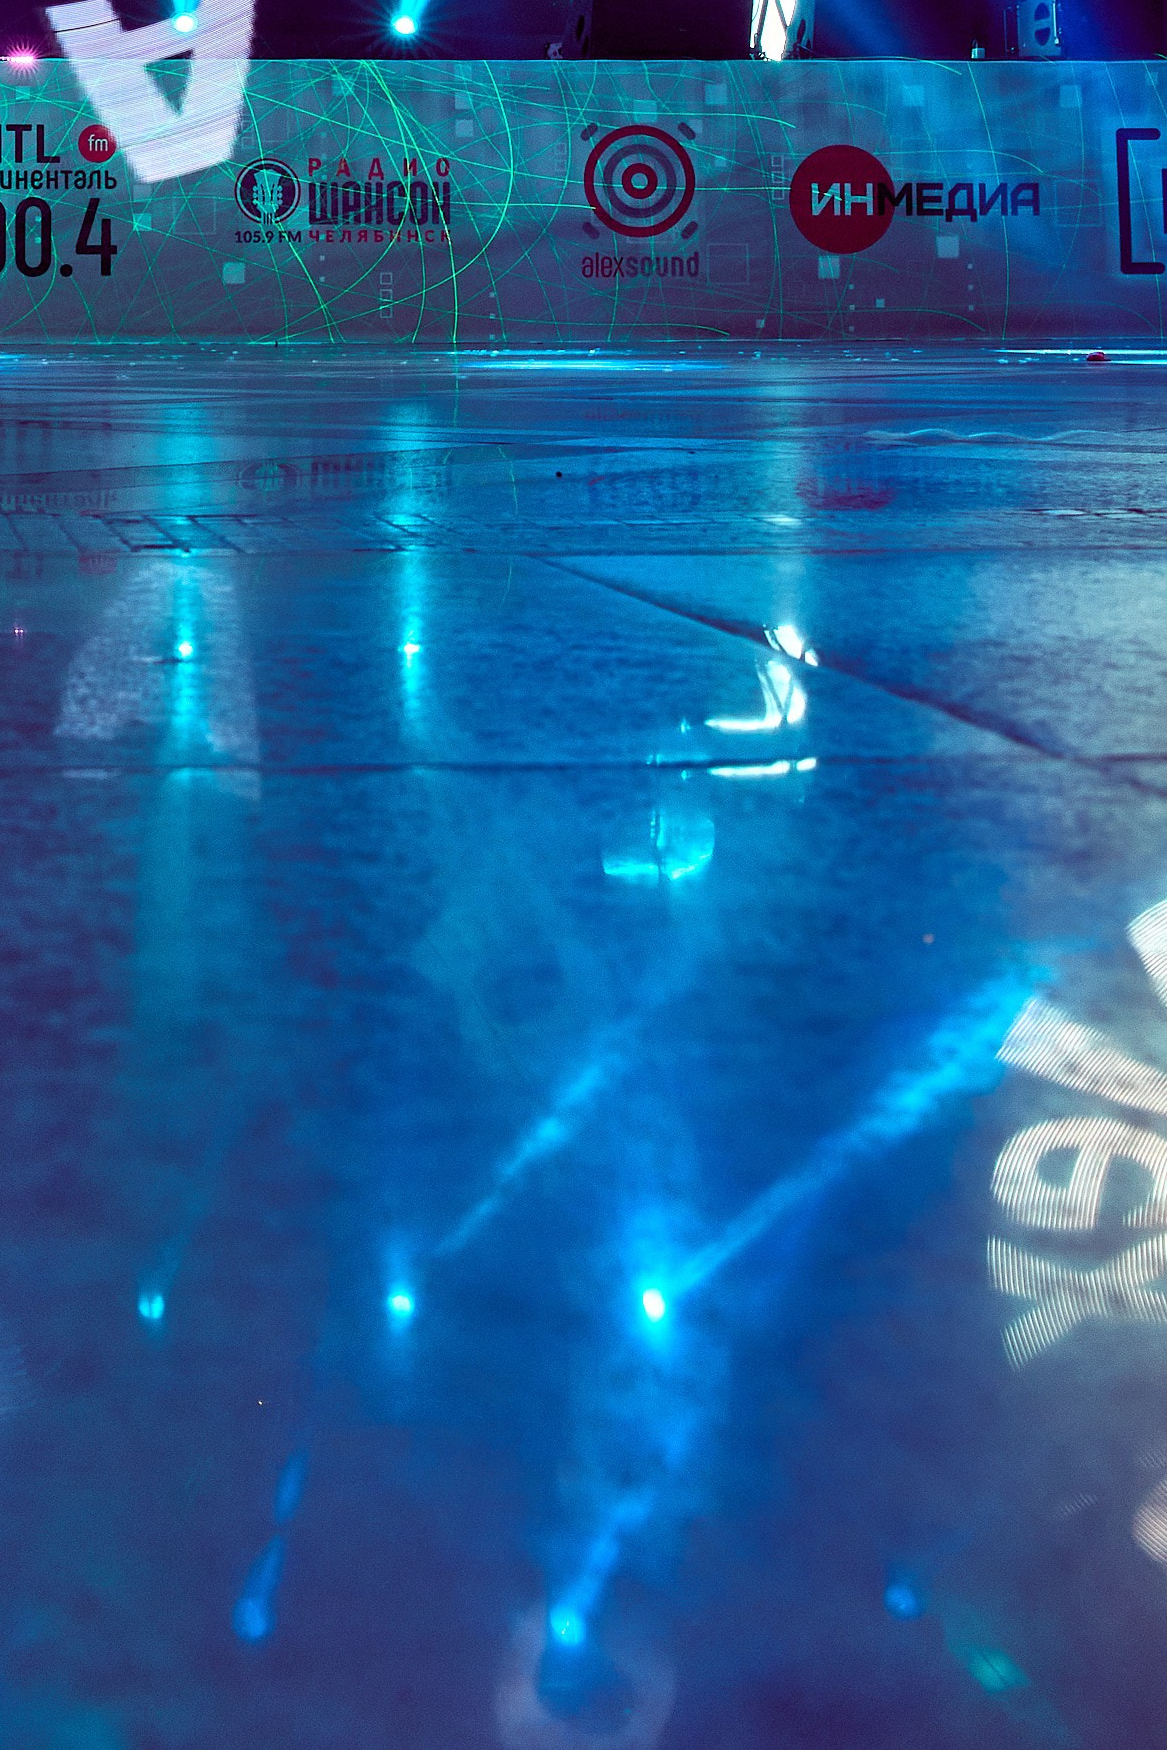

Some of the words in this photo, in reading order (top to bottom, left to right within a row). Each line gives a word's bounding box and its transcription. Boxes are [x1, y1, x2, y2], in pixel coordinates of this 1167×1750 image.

[87, 133, 109, 152] fm
[308, 158, 450, 180] РАДИО
[308, 181, 450, 225] ШАНСОН
[234, 231, 274, 243] 105.9
[278, 231, 302, 243] FM
[308, 230, 451, 243] ЧЕЛЯБИНСК
[581, 252, 700, 279] alexsound
